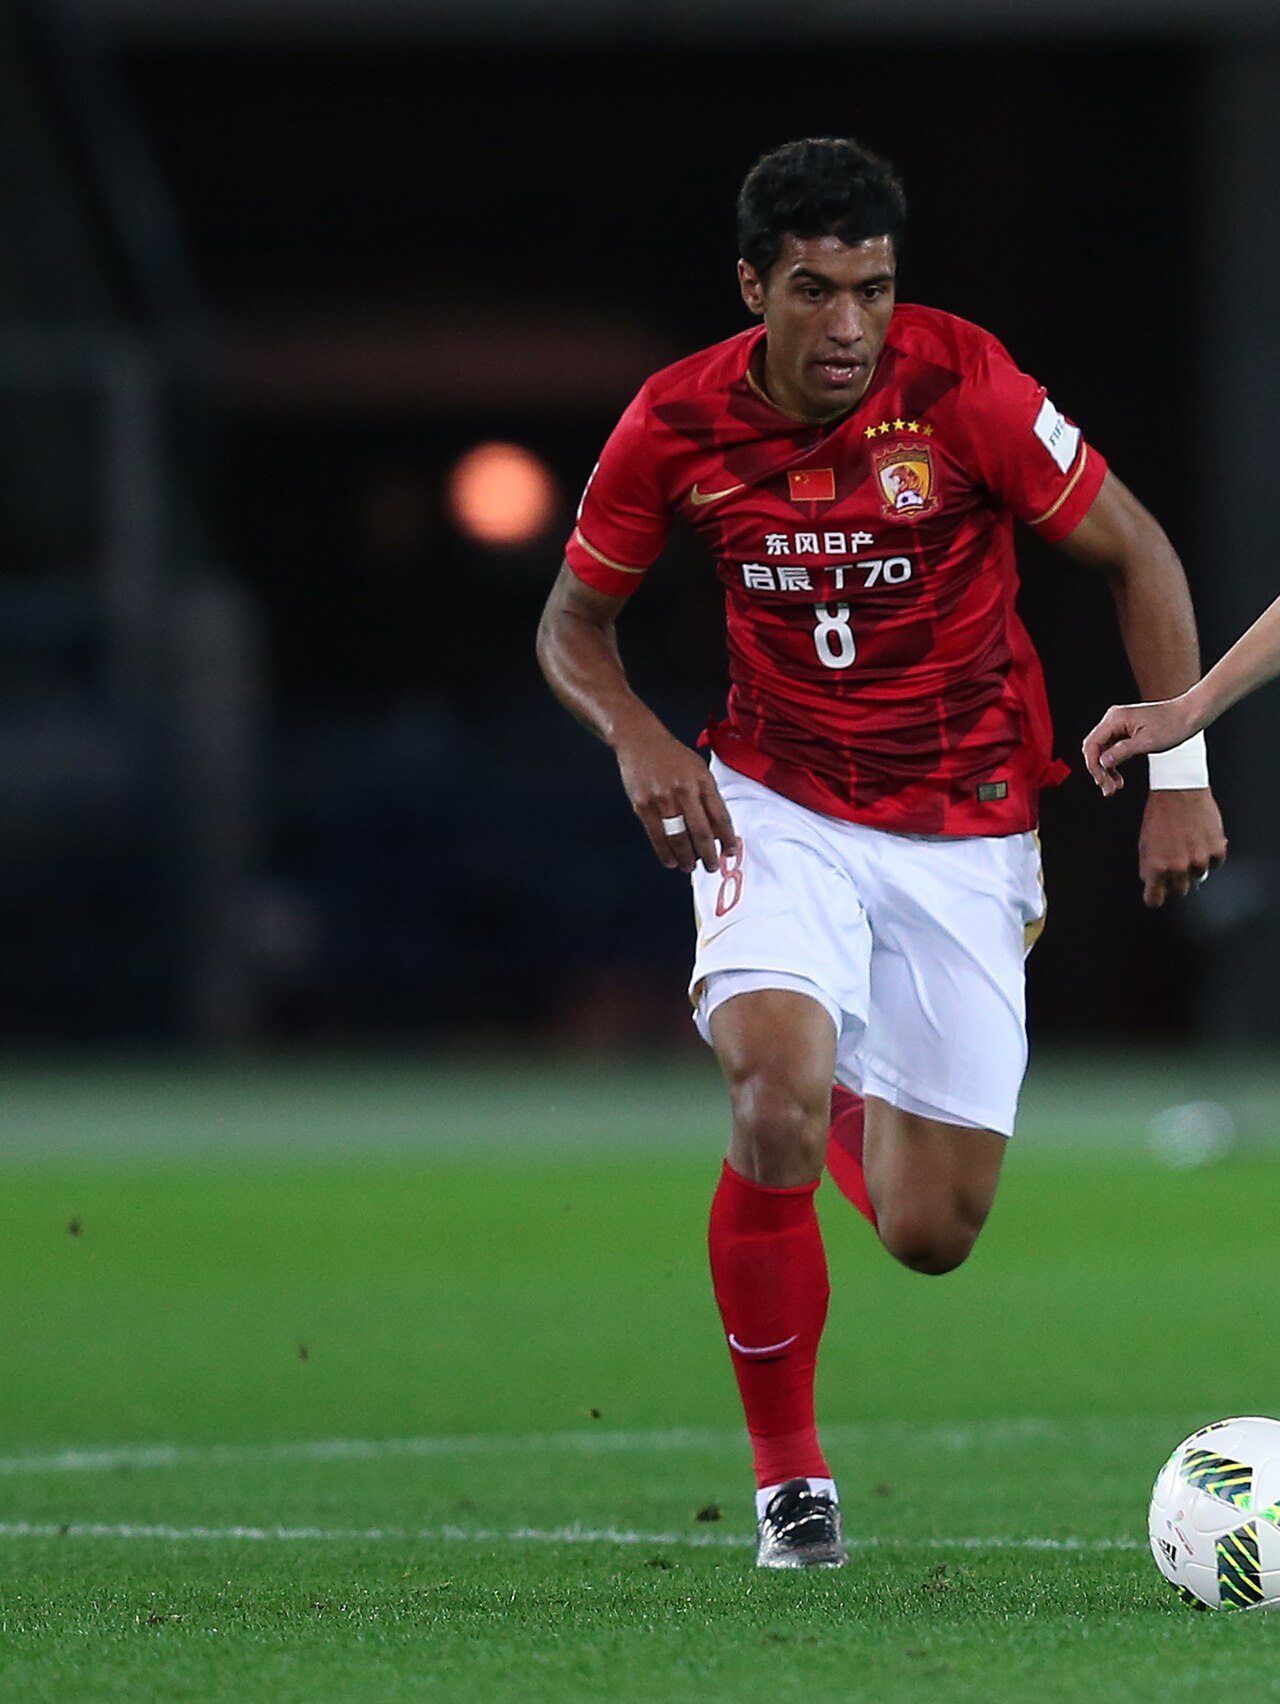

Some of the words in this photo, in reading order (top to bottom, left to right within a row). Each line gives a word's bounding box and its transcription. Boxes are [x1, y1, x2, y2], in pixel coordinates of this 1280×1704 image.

[765, 531, 874, 555] 东风日产
[742, 563, 814, 591] 启辰
[824, 557, 912, 589] T70
[813, 602, 856, 669] 8
[716, 835, 744, 917] 8
